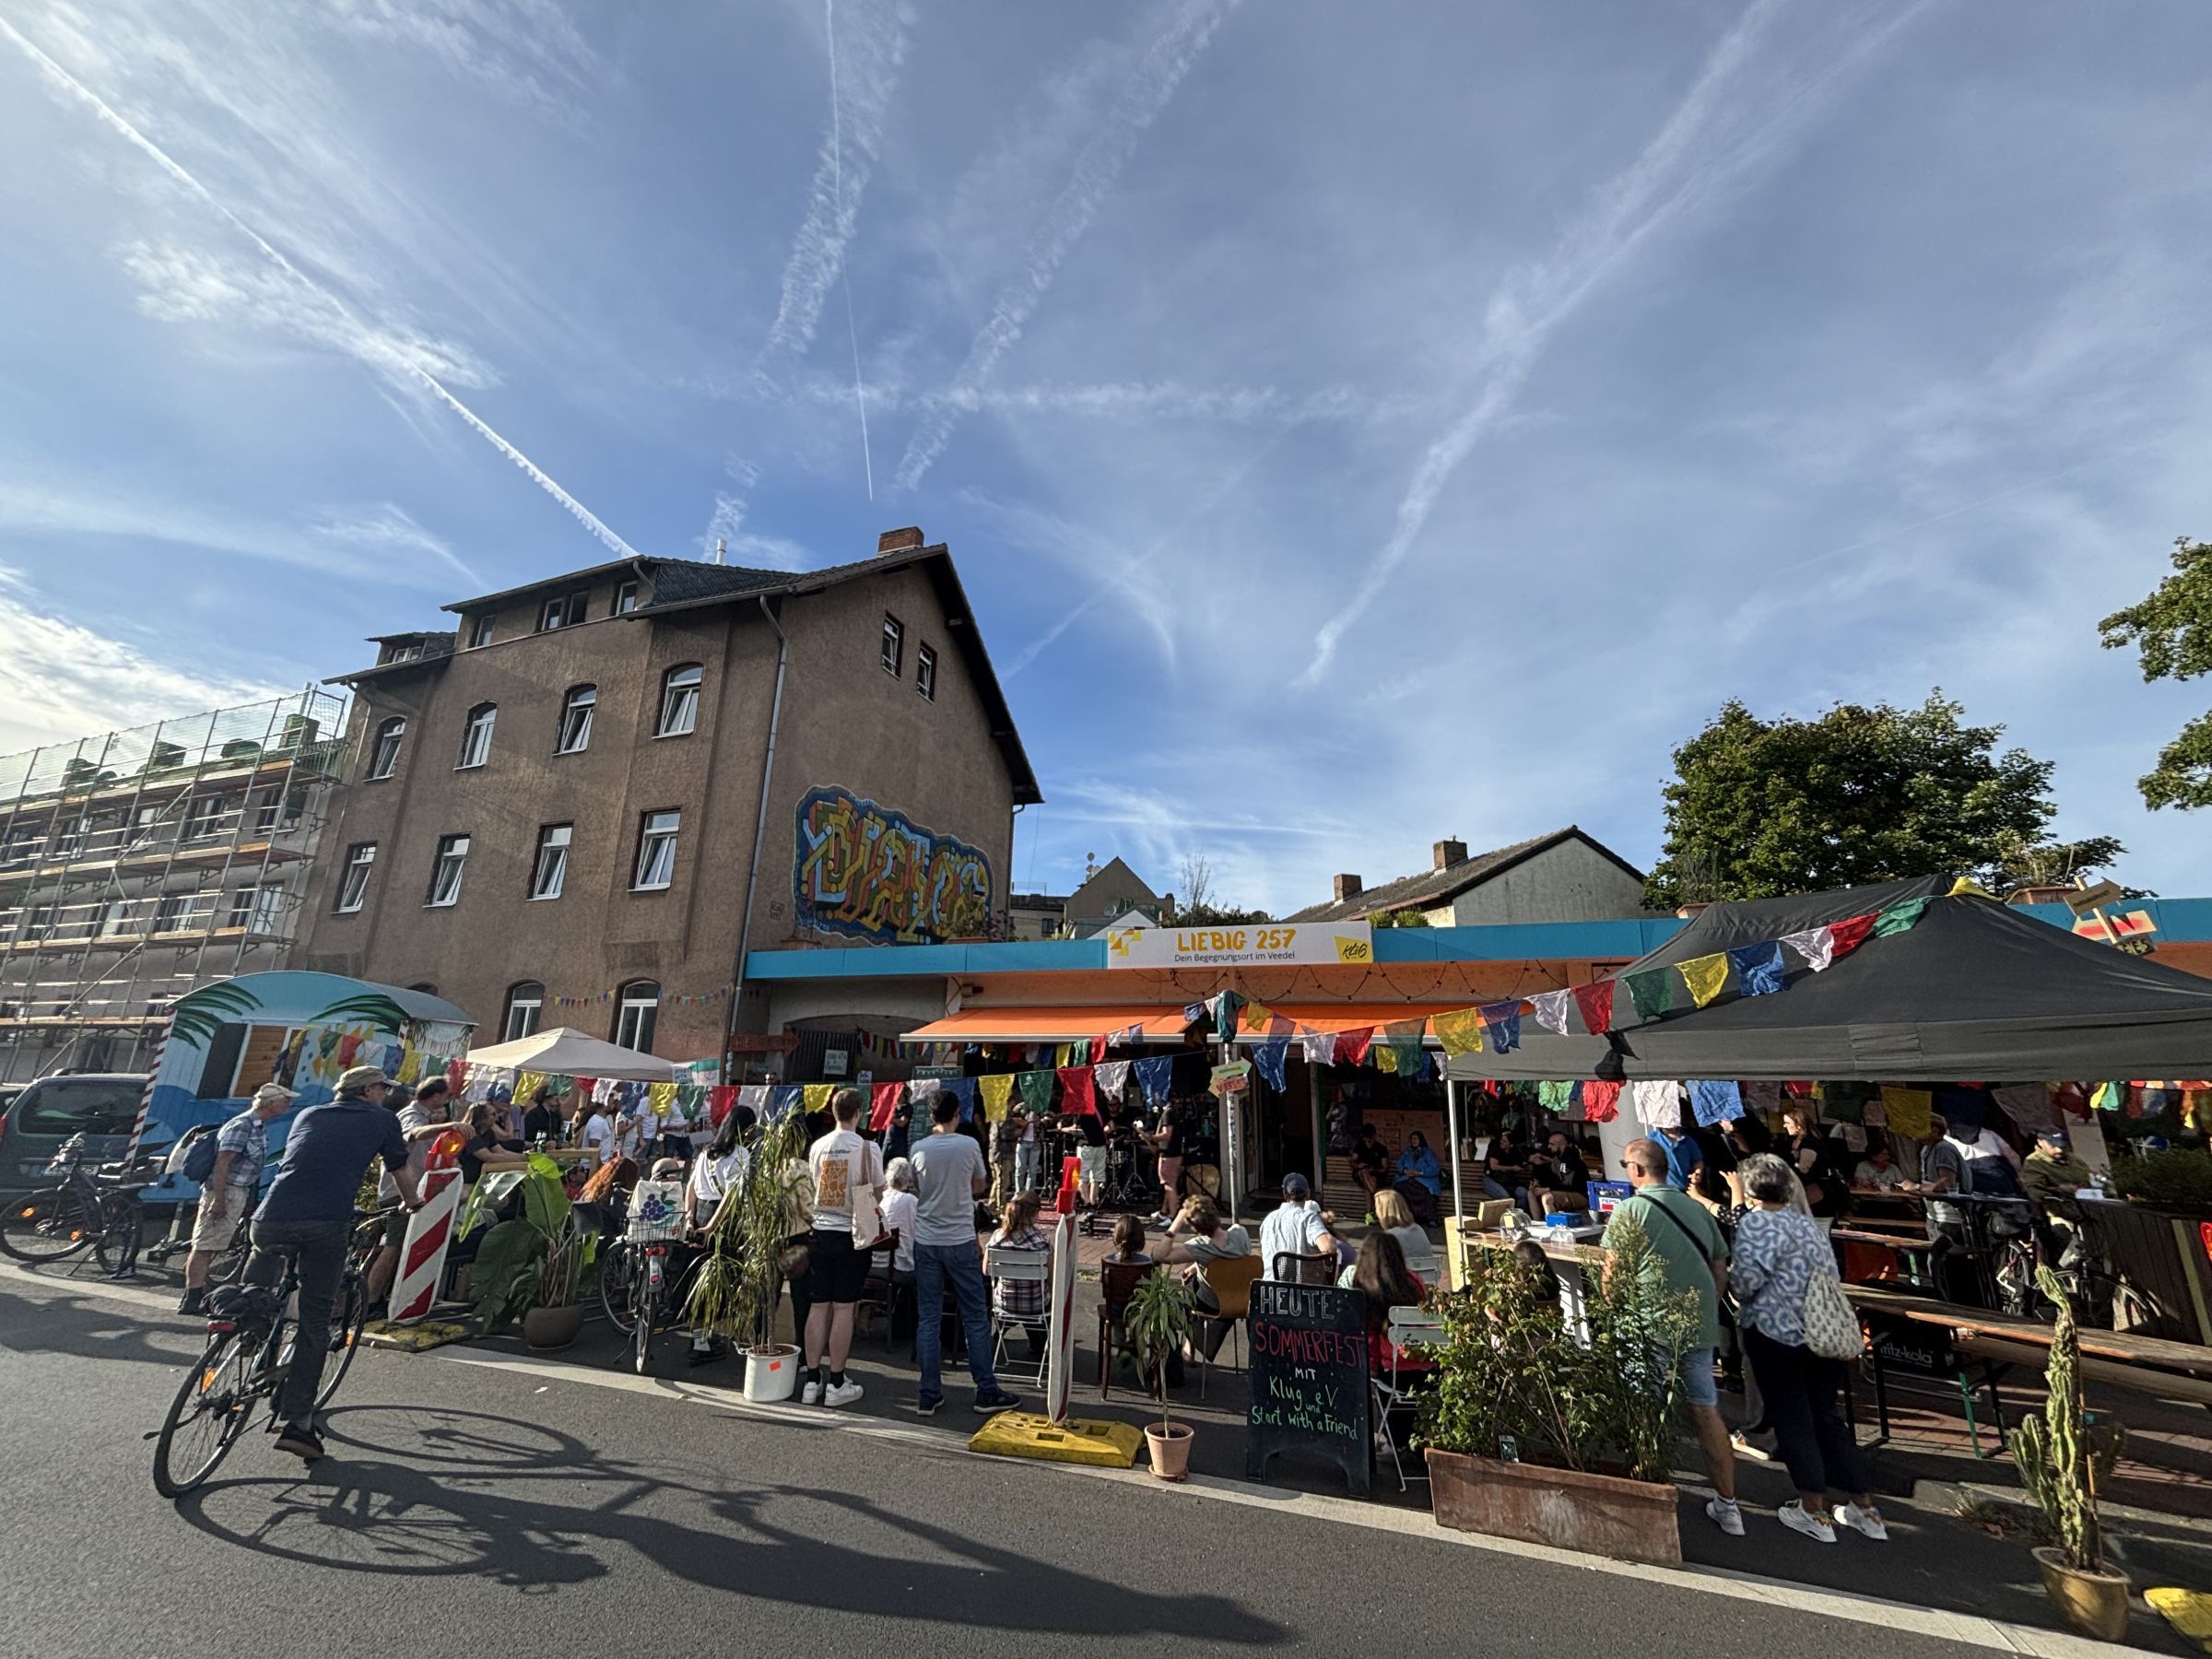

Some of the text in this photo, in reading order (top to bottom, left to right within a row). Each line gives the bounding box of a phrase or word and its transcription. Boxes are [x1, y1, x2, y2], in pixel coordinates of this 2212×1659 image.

[1177, 928, 1297, 952] LIEBIG 257
[1174, 951, 1295, 963] Dein Begegnungsort im Veedel
[1253, 1321, 1364, 1369] SOMMERFEST
[1295, 1368, 1316, 1381] MIT
[1269, 1375, 1302, 1412] Klug
[1306, 1404, 1321, 1414] und
[1252, 1406, 1359, 1441] Start with a Friend
